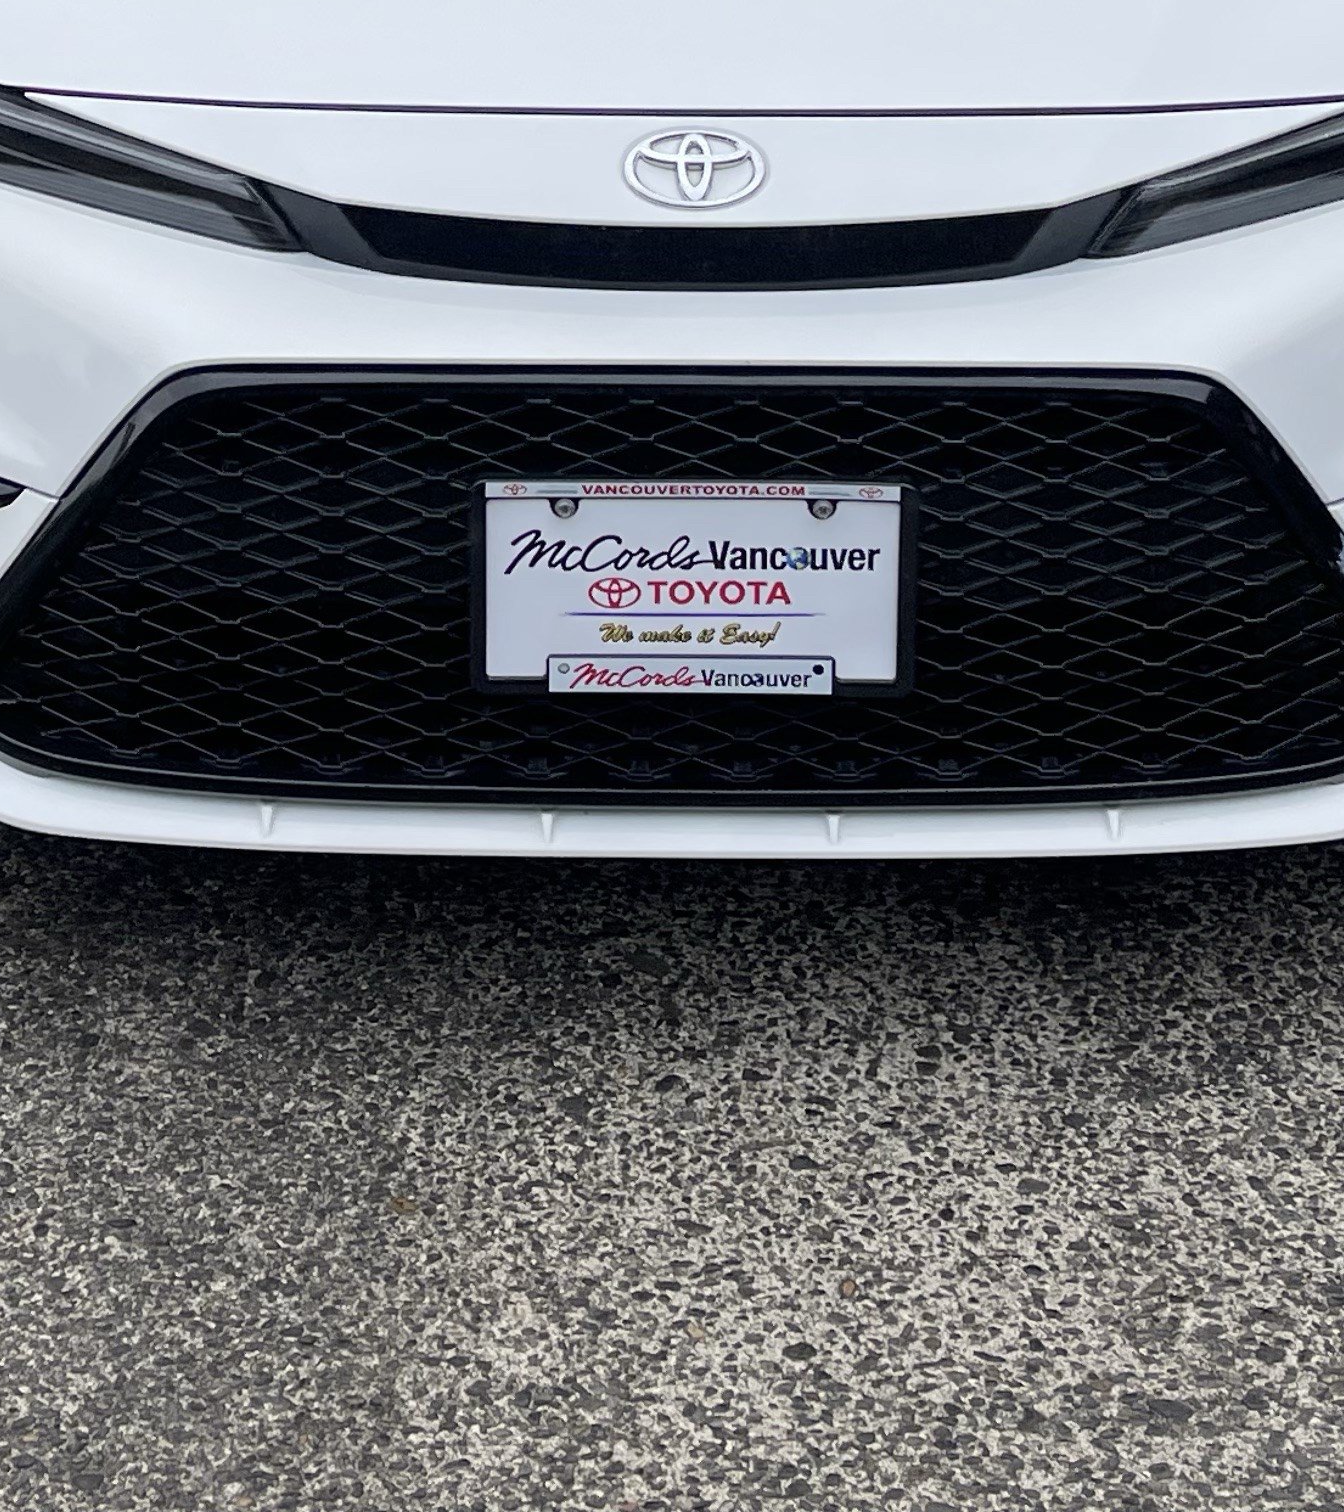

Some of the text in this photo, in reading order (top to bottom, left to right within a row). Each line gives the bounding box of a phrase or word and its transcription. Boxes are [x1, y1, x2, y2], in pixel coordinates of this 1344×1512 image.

[581, 484, 806, 497] VANCOUVERTOYOTA.COM
[504, 529, 881, 575] McCords Vancouver
[647, 580, 792, 606] TOYOTA
[599, 621, 782, 648] We make it Easy!
